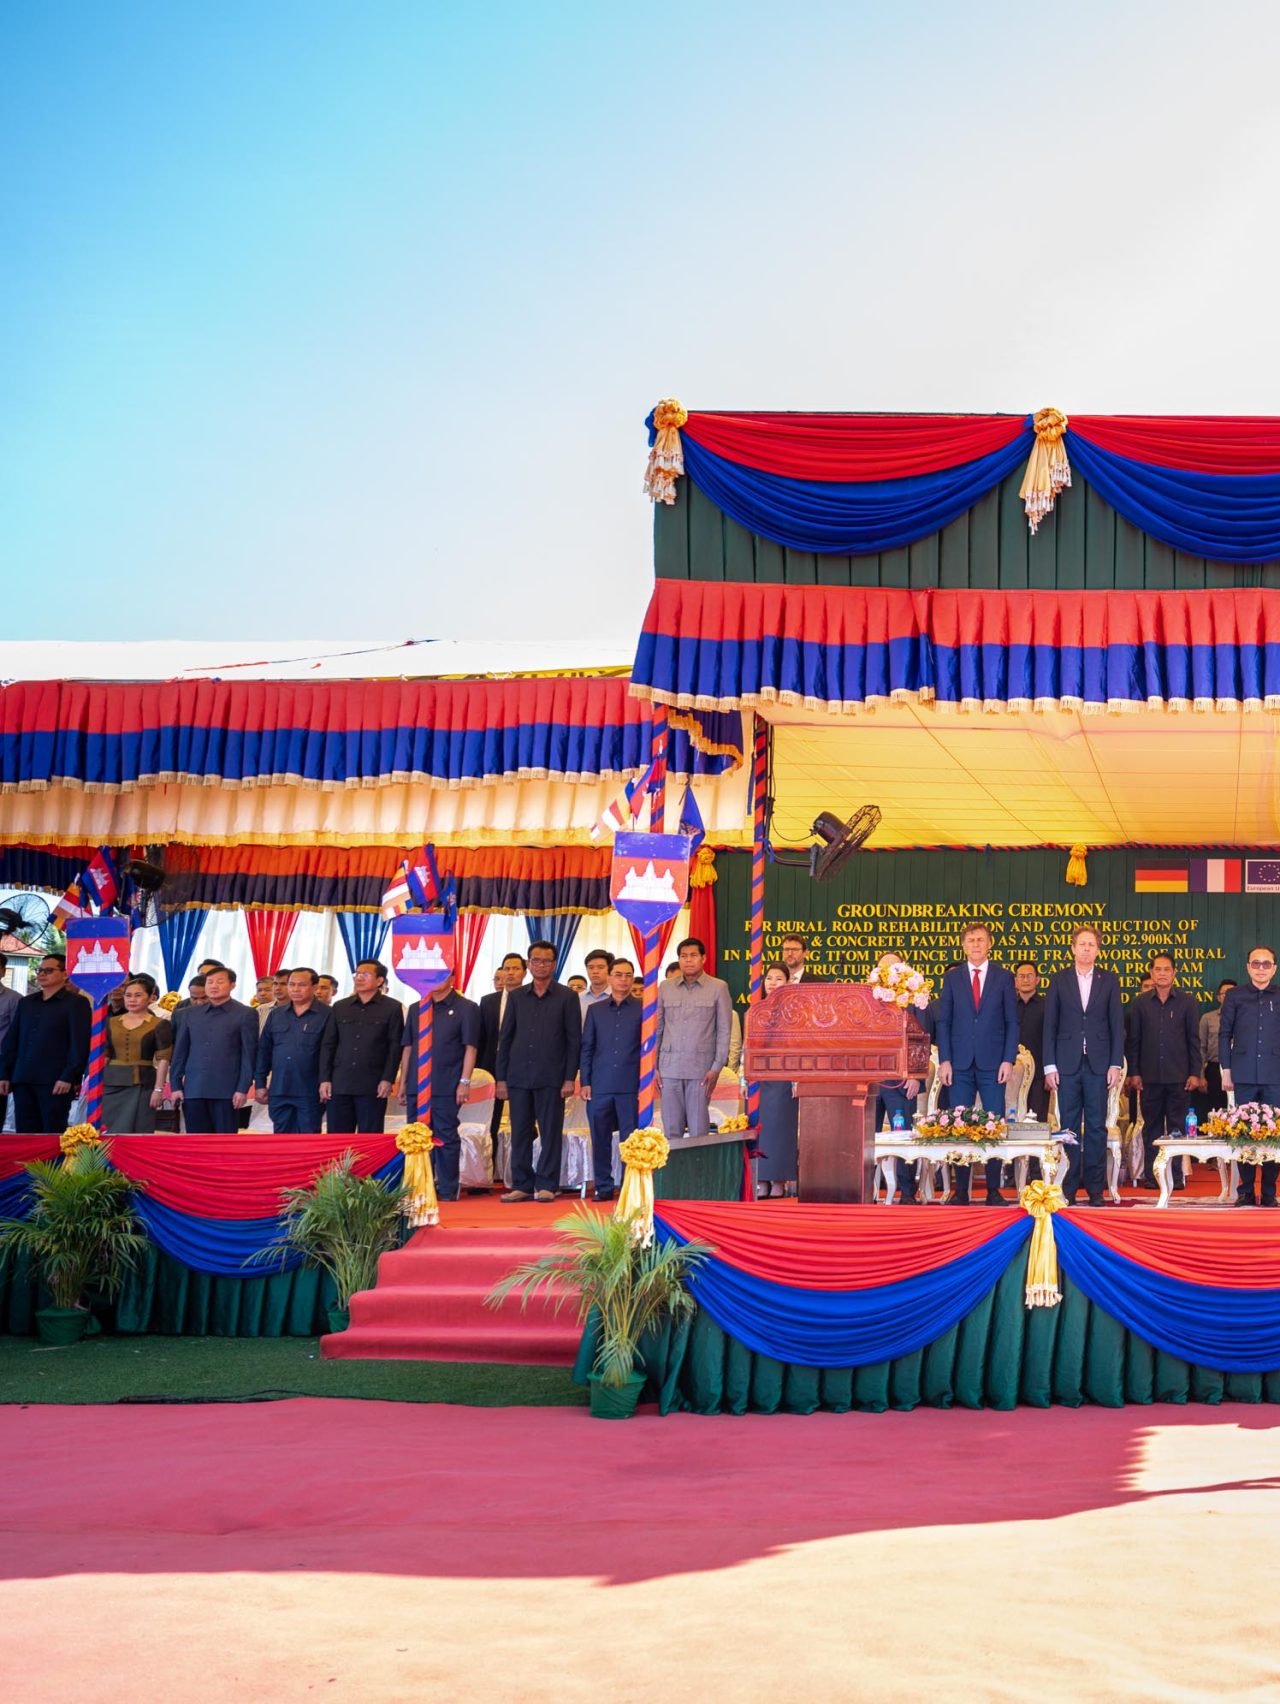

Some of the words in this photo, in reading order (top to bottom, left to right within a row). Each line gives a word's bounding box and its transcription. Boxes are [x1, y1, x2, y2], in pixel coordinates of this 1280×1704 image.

[837, 903, 1003, 918] GROUNDBREAKING
[1008, 903, 1107, 917] CEREMONY
[744, 920, 772, 932] FR
[776, 920, 827, 932] RURAL
[832, 921, 874, 933] ROAD
[878, 920, 1005, 933] REHABILITAON
[1010, 920, 1044, 932] AND
[1178, 919, 1199, 931] OF
[810, 935, 823, 947] &
[826, 935, 905, 947] CONCRETE
[910, 935, 995, 947] PAVEM)
[998, 935, 1017, 946] AS
[1019, 935, 1030, 946] A
[1101, 934, 1121, 946] OF
[1123, 933, 1187, 945] 92.900KM
[723, 949, 741, 961] IN
[874, 949, 948, 962] PVINCE
[1007, 949, 1039, 961] THE
[1044, 948, 1142, 961] FRAWORK
[1173, 947, 1226, 960] RURAL
[1125, 962, 1204, 974] PROAM
